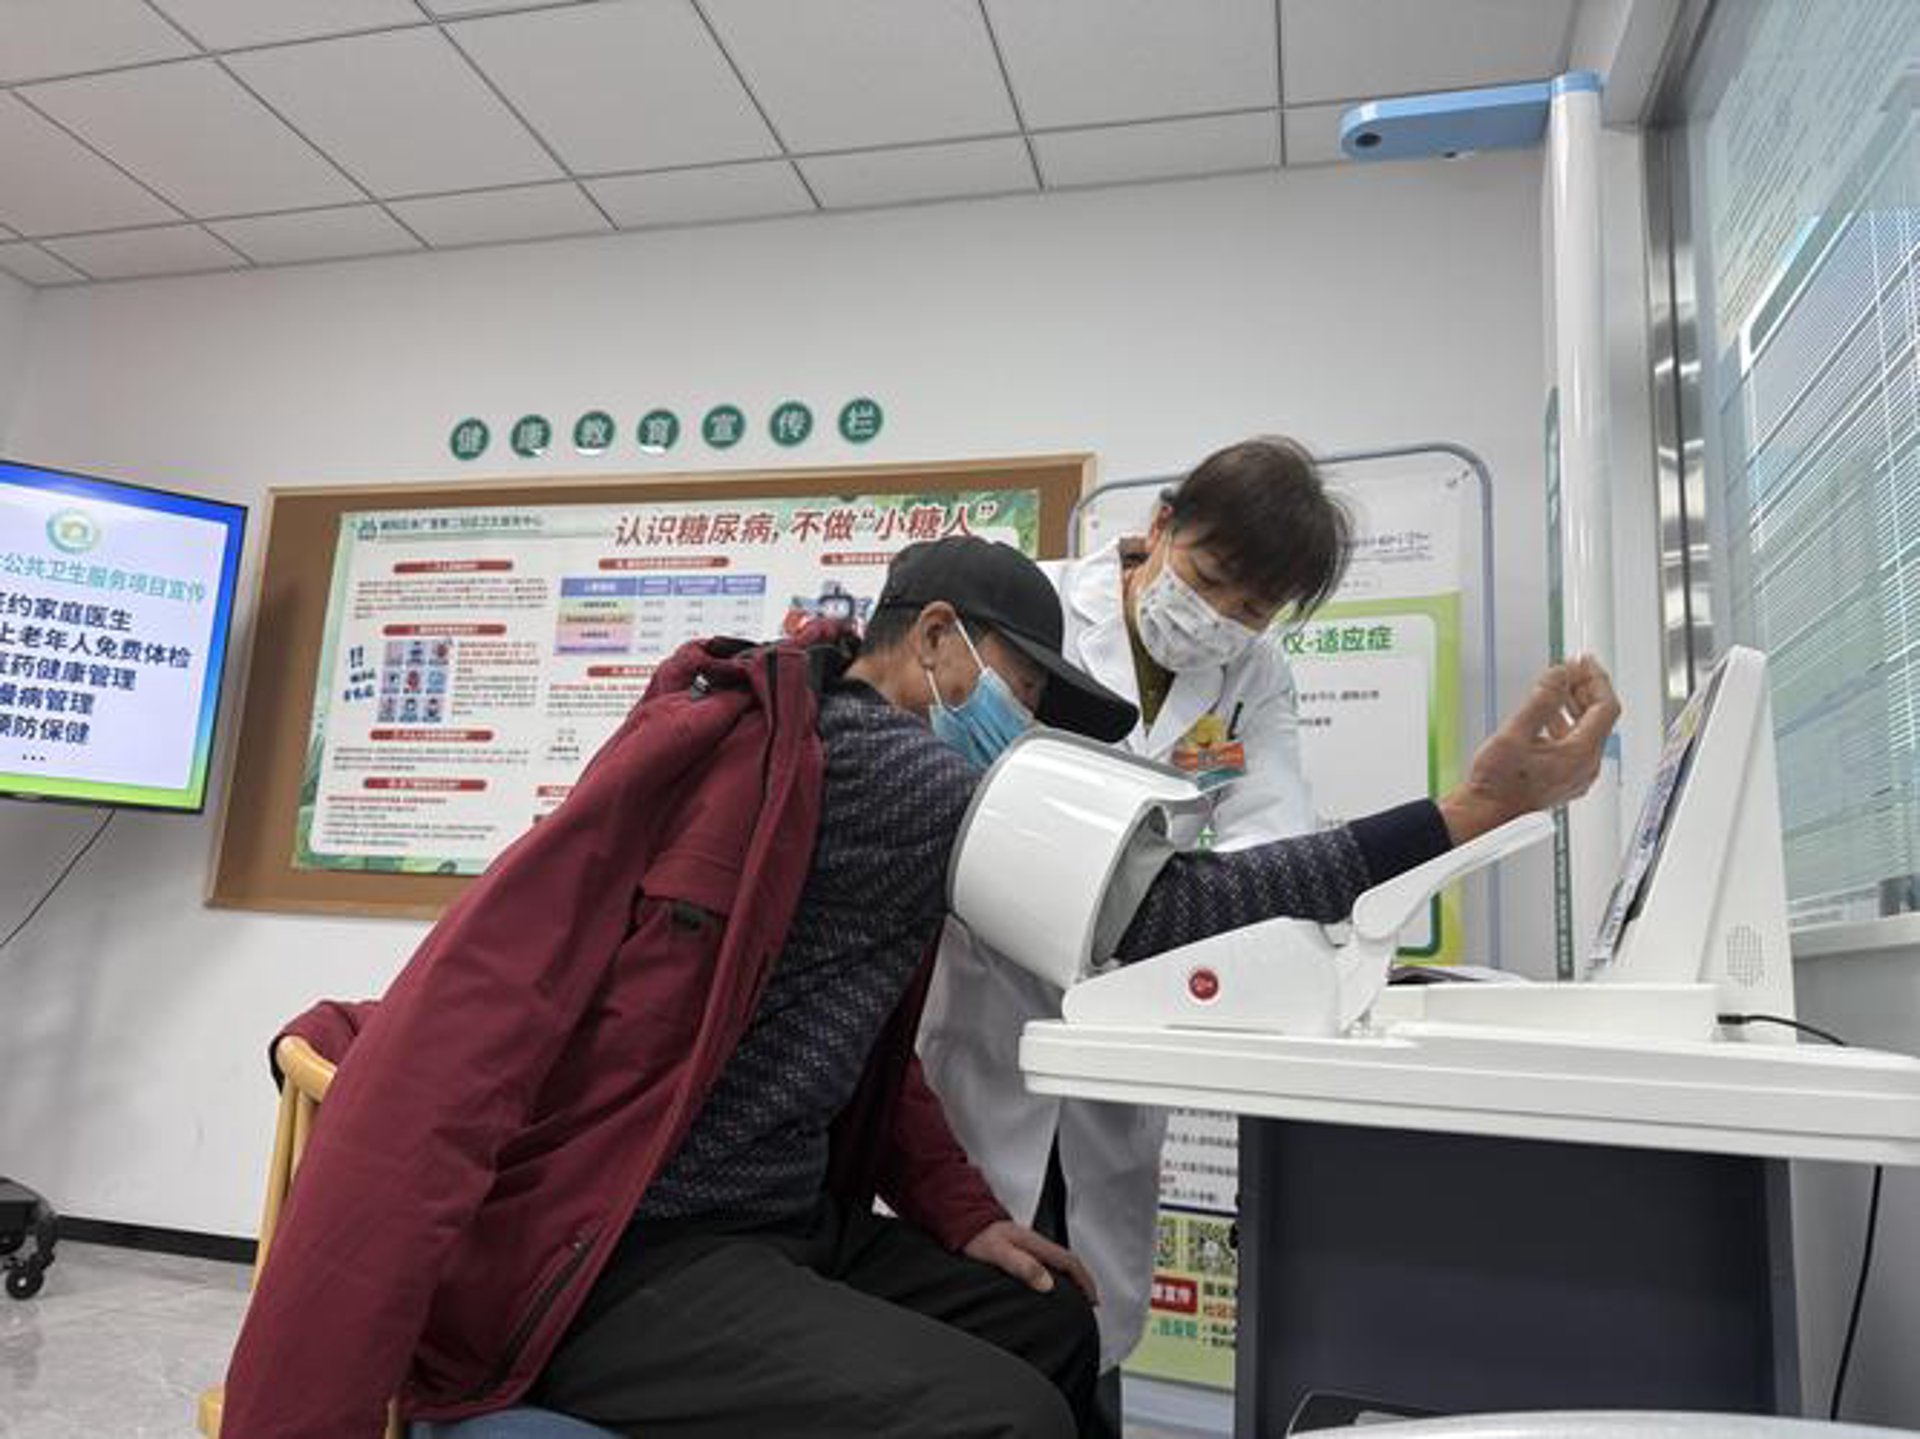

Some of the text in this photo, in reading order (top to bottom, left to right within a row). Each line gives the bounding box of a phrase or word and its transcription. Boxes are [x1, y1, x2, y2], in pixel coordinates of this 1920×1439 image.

[457, 404, 876, 453] 健康教育宣传栏
[0, 552, 206, 602] 公共卫生服务项目宣传
[0, 591, 132, 632] 约家庭医生
